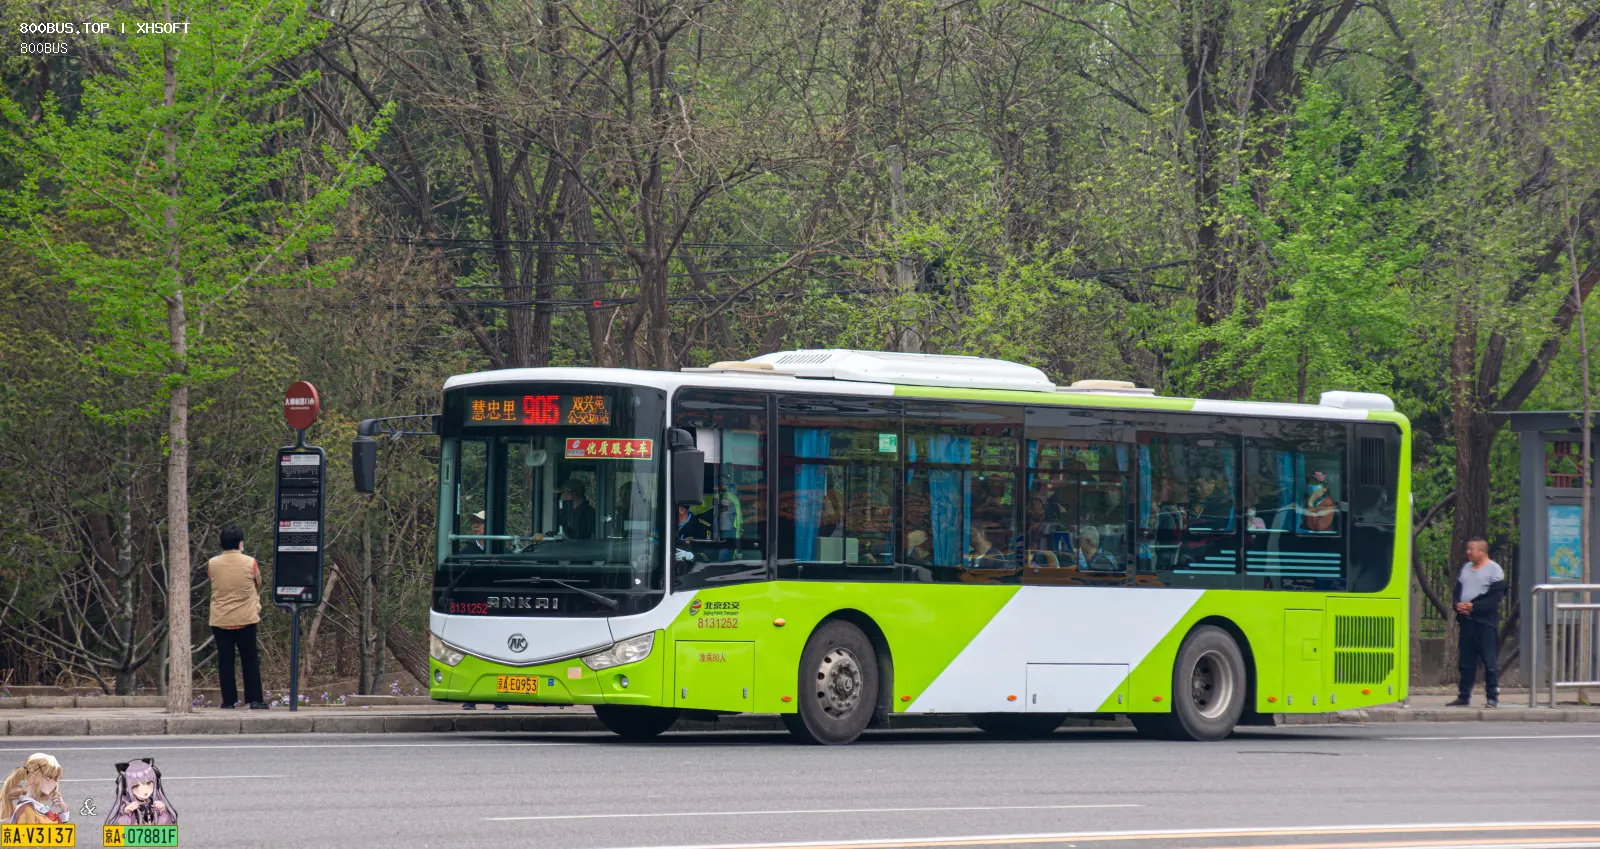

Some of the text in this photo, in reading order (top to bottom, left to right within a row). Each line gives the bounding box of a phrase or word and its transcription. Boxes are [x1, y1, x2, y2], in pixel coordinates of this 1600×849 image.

[471, 399, 517, 421] 慧忠里
[521, 395, 561, 425] 905
[572, 395, 605, 410] 双兴苑
[567, 409, 610, 425] 公交场站
[586, 440, 648, 457] 优质服务车
[449, 602, 488, 614] 8131252
[487, 596, 559, 609] ANKAI
[703, 601, 740, 610] 北京公交
[697, 617, 738, 629] 8131252
